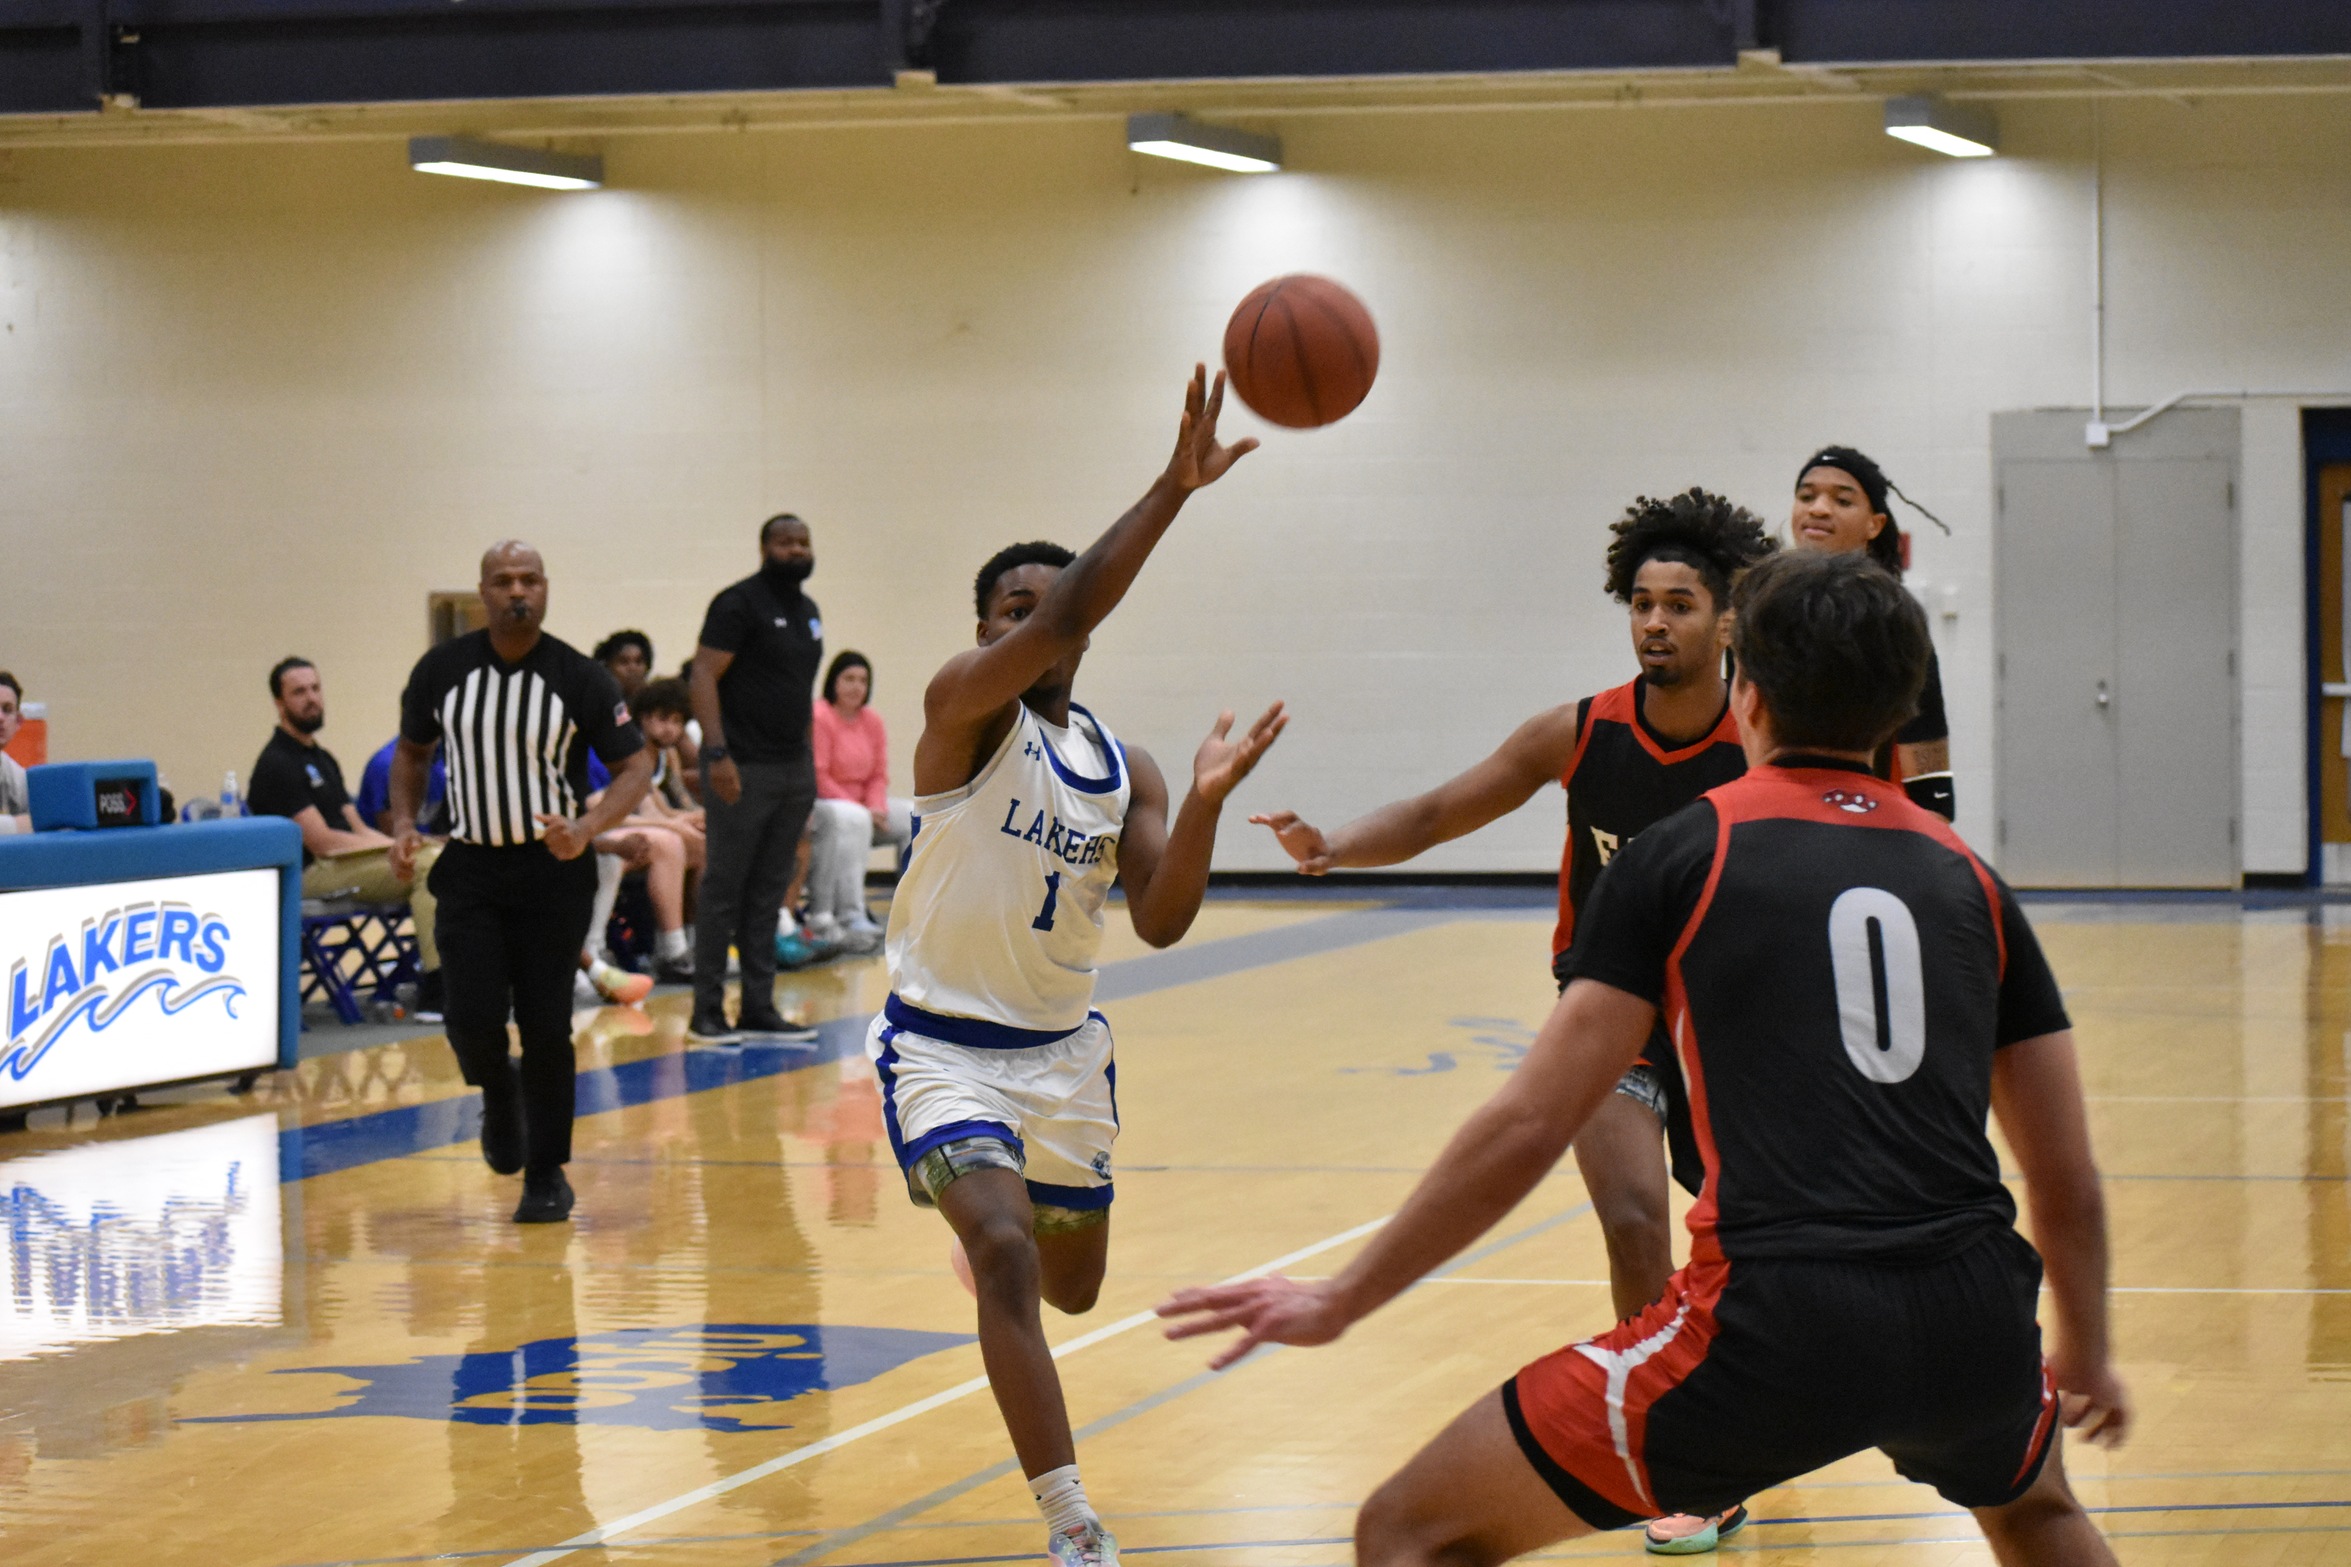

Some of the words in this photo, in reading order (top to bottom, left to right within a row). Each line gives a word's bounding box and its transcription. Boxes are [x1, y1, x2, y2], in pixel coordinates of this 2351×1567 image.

[6, 901, 231, 1042] LAKERS
[1031, 871, 1060, 932] 1
[1828, 887, 1926, 1084] 0
